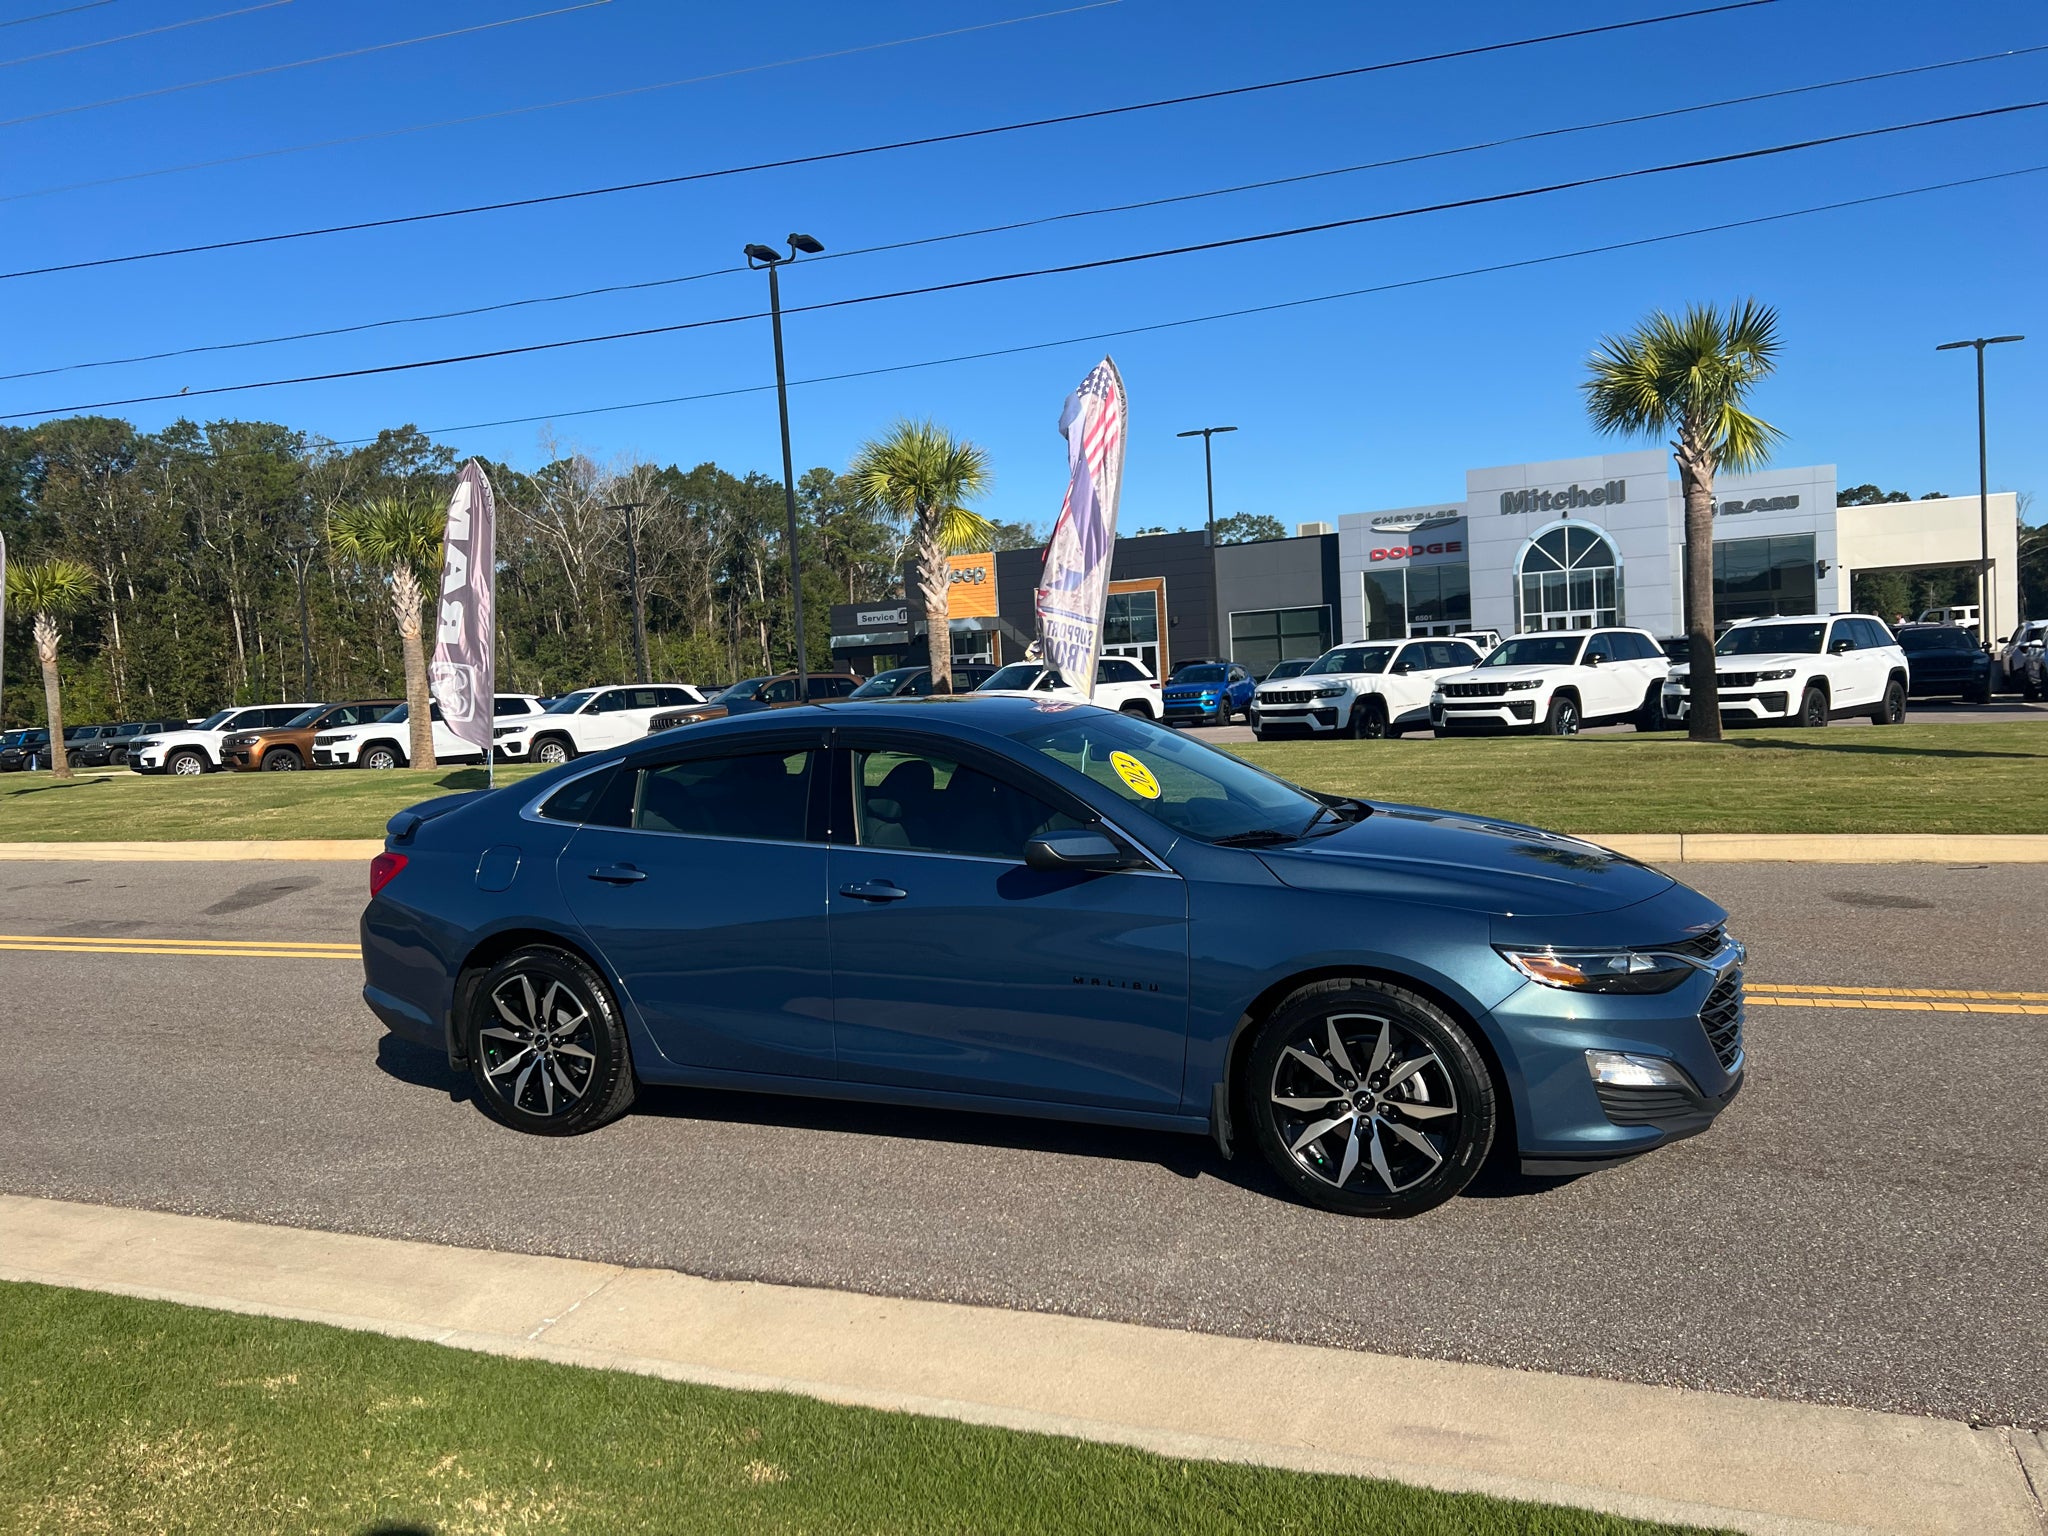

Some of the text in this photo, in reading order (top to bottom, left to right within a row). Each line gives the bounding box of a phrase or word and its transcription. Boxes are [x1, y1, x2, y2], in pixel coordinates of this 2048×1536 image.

[1500, 479, 1626, 515] Mitchell
[1720, 495, 1800, 516] RAM
[1371, 509, 1458, 525] CHRYSLER
[1369, 541, 1462, 562] DODGE
[950, 566, 986, 585] eep
[861, 613, 895, 623] Service
[1415, 614, 1433, 622] 6501
[1072, 975, 1160, 992] MALIBU
